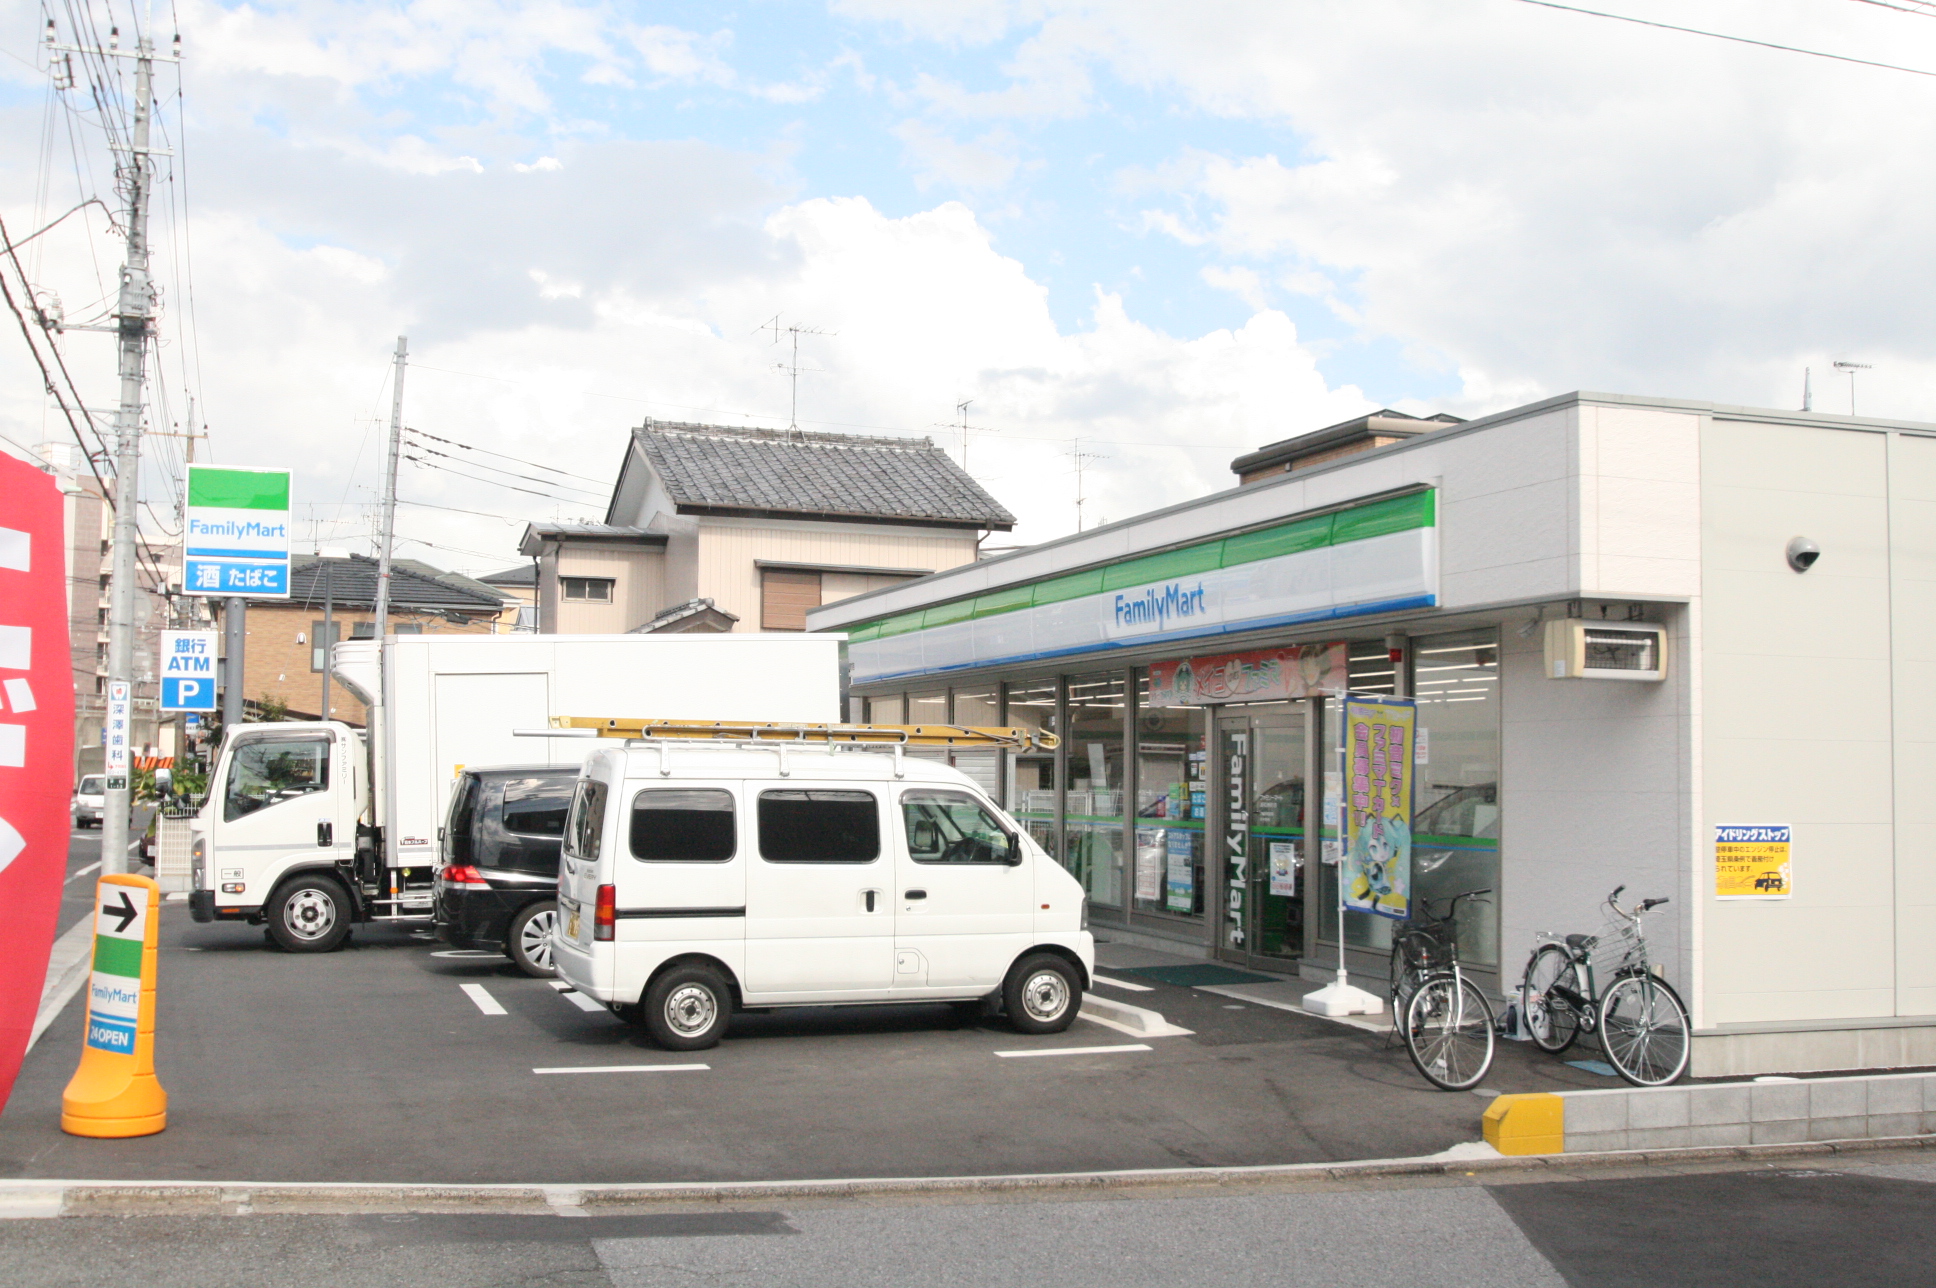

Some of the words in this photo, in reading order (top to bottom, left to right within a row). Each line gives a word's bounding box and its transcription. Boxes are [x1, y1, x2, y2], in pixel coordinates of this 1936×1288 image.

[190, 519, 285, 540] FamilyMart
[196, 564, 220, 588] 酒
[228, 568, 278, 587] たばこ
[1115, 581, 1206, 631] FamilyMart
[174, 638, 206, 654] 銀行
[167, 656, 210, 672] ATM
[178, 680, 200, 706] P
[1226, 733, 1247, 944] FamilyMart
[1715, 828, 1789, 841] アイドリングストップ
[224, 870, 242, 878] 一般
[92, 983, 137, 1004] FamilyMart
